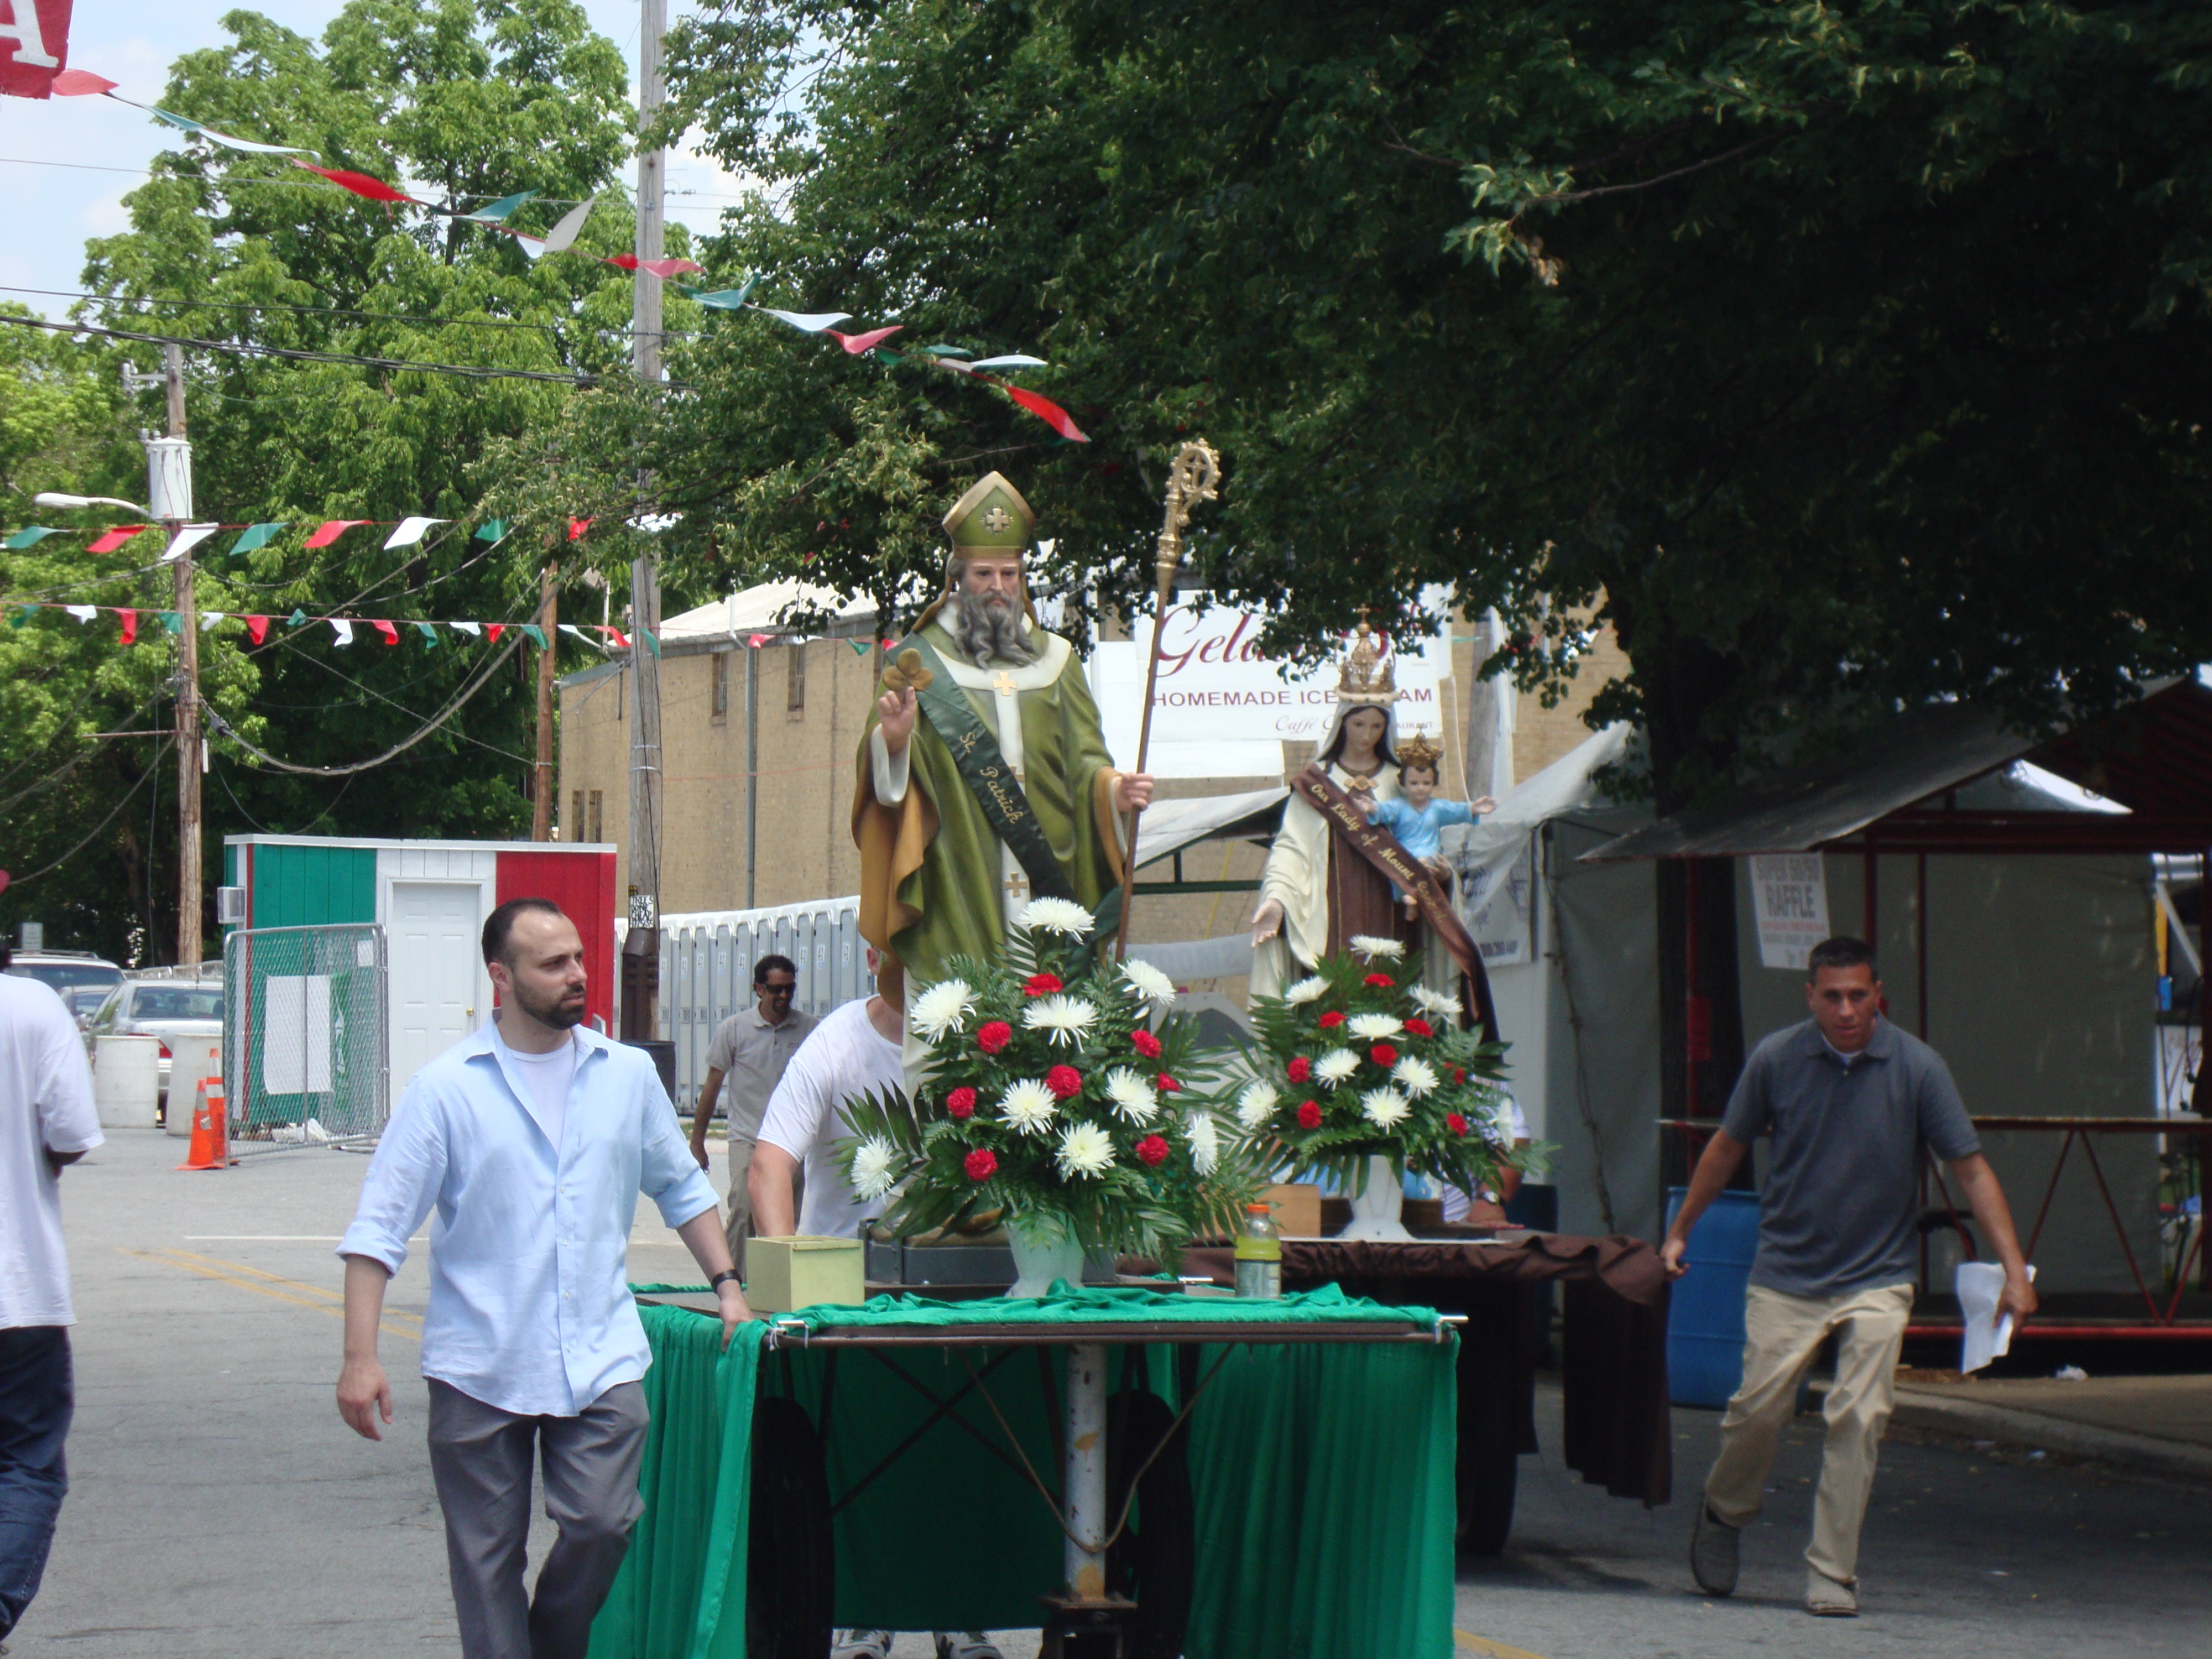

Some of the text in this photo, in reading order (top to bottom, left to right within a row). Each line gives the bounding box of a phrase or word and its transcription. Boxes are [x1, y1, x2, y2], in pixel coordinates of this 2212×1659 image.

[1156, 604, 1319, 678] Gela
[1154, 690, 1337, 706] HOMEMADE ICE
[960, 732, 1024, 824] St. Patrick
[1312, 784, 1329, 802] Our
[1331, 803, 1360, 831] Lady
[1361, 833, 1379, 847] of
[1378, 847, 1415, 880] Mount
